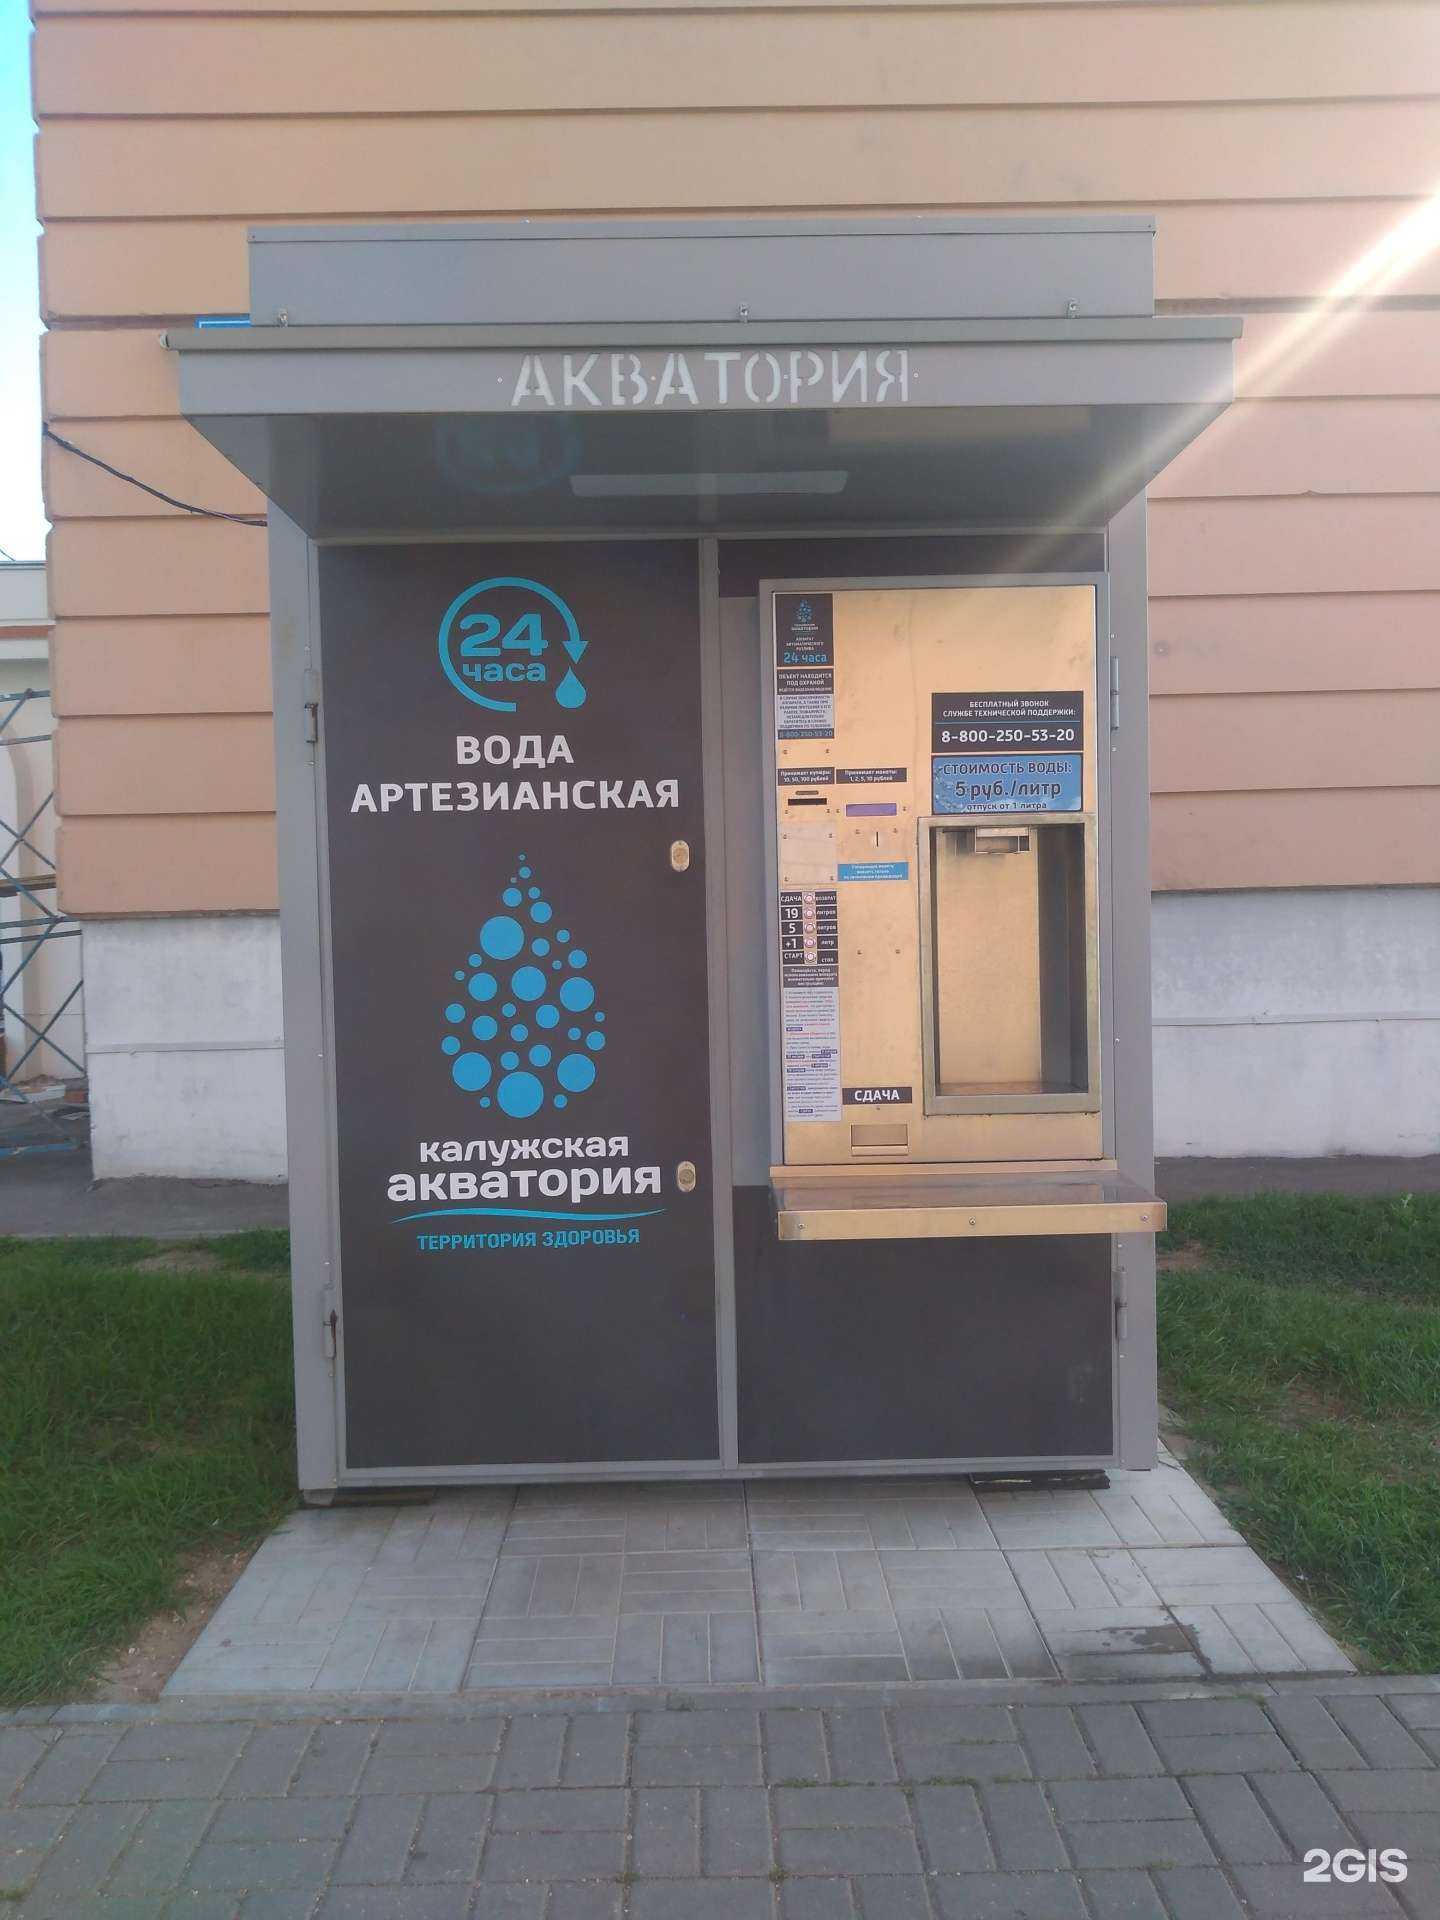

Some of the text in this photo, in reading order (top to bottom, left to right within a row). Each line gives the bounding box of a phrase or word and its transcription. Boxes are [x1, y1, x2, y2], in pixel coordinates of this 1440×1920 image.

[511, 350, 909, 406] АКВАТОРИЯ
[460, 613, 548, 656] 24
[784, 652, 800, 663] 24
[461, 662, 547, 682] часа
[969, 700, 1049, 708] БЕСПЛАТНЫЙ ЗВОНОК
[943, 707, 1076, 717] СЛУЖБЕ ТЕХНИЧЕСКОЙ ПОДДЕРЖКИ:
[941, 728, 1075, 743] 8-800-250-53-20
[456, 735, 574, 769] ВОДА
[943, 761, 1072, 776] СТОИМОСТЬ ВОДЫ:
[350, 779, 680, 813] АРТЕЗИАНСКАЯ
[955, 781, 966, 797] 5
[1020, 802, 1048, 810] литра
[785, 908, 798, 919] 19
[788, 923, 796, 934] 5
[854, 1089, 900, 1102] СДАЧА
[419, 1136, 630, 1166] калужская
[387, 1166, 661, 1203] акватория
[416, 1228, 641, 1250] ТЕРРИТОРИЯ ЗДОРОВЬЯ
